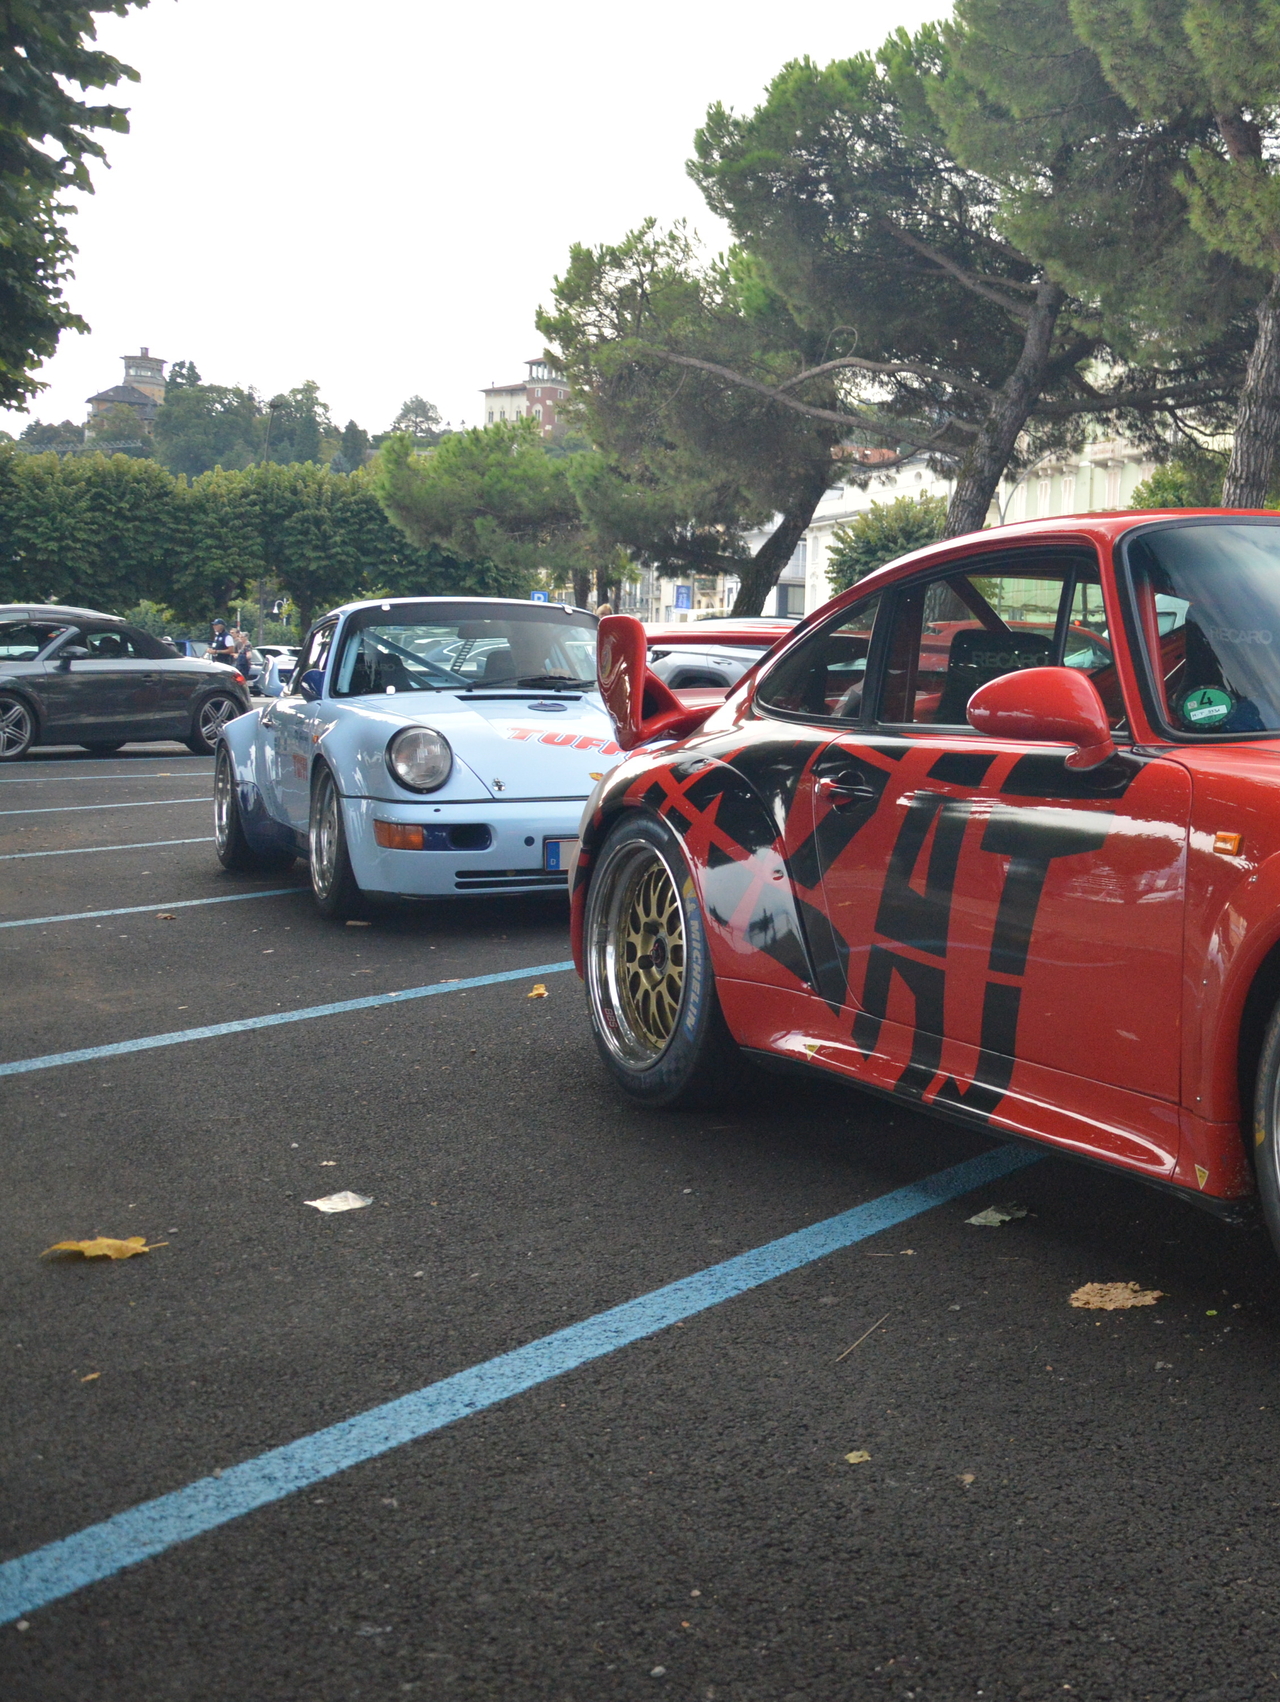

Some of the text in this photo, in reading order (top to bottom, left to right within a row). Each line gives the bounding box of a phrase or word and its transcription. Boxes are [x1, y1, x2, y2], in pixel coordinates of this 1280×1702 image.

[1209, 627, 1273, 645] RECARO
[972, 651, 1050, 669] RECARO
[1199, 690, 1213, 706] 4
[685, 920, 700, 1032] MICHELIN
[604, 1008, 618, 1028] BBS
